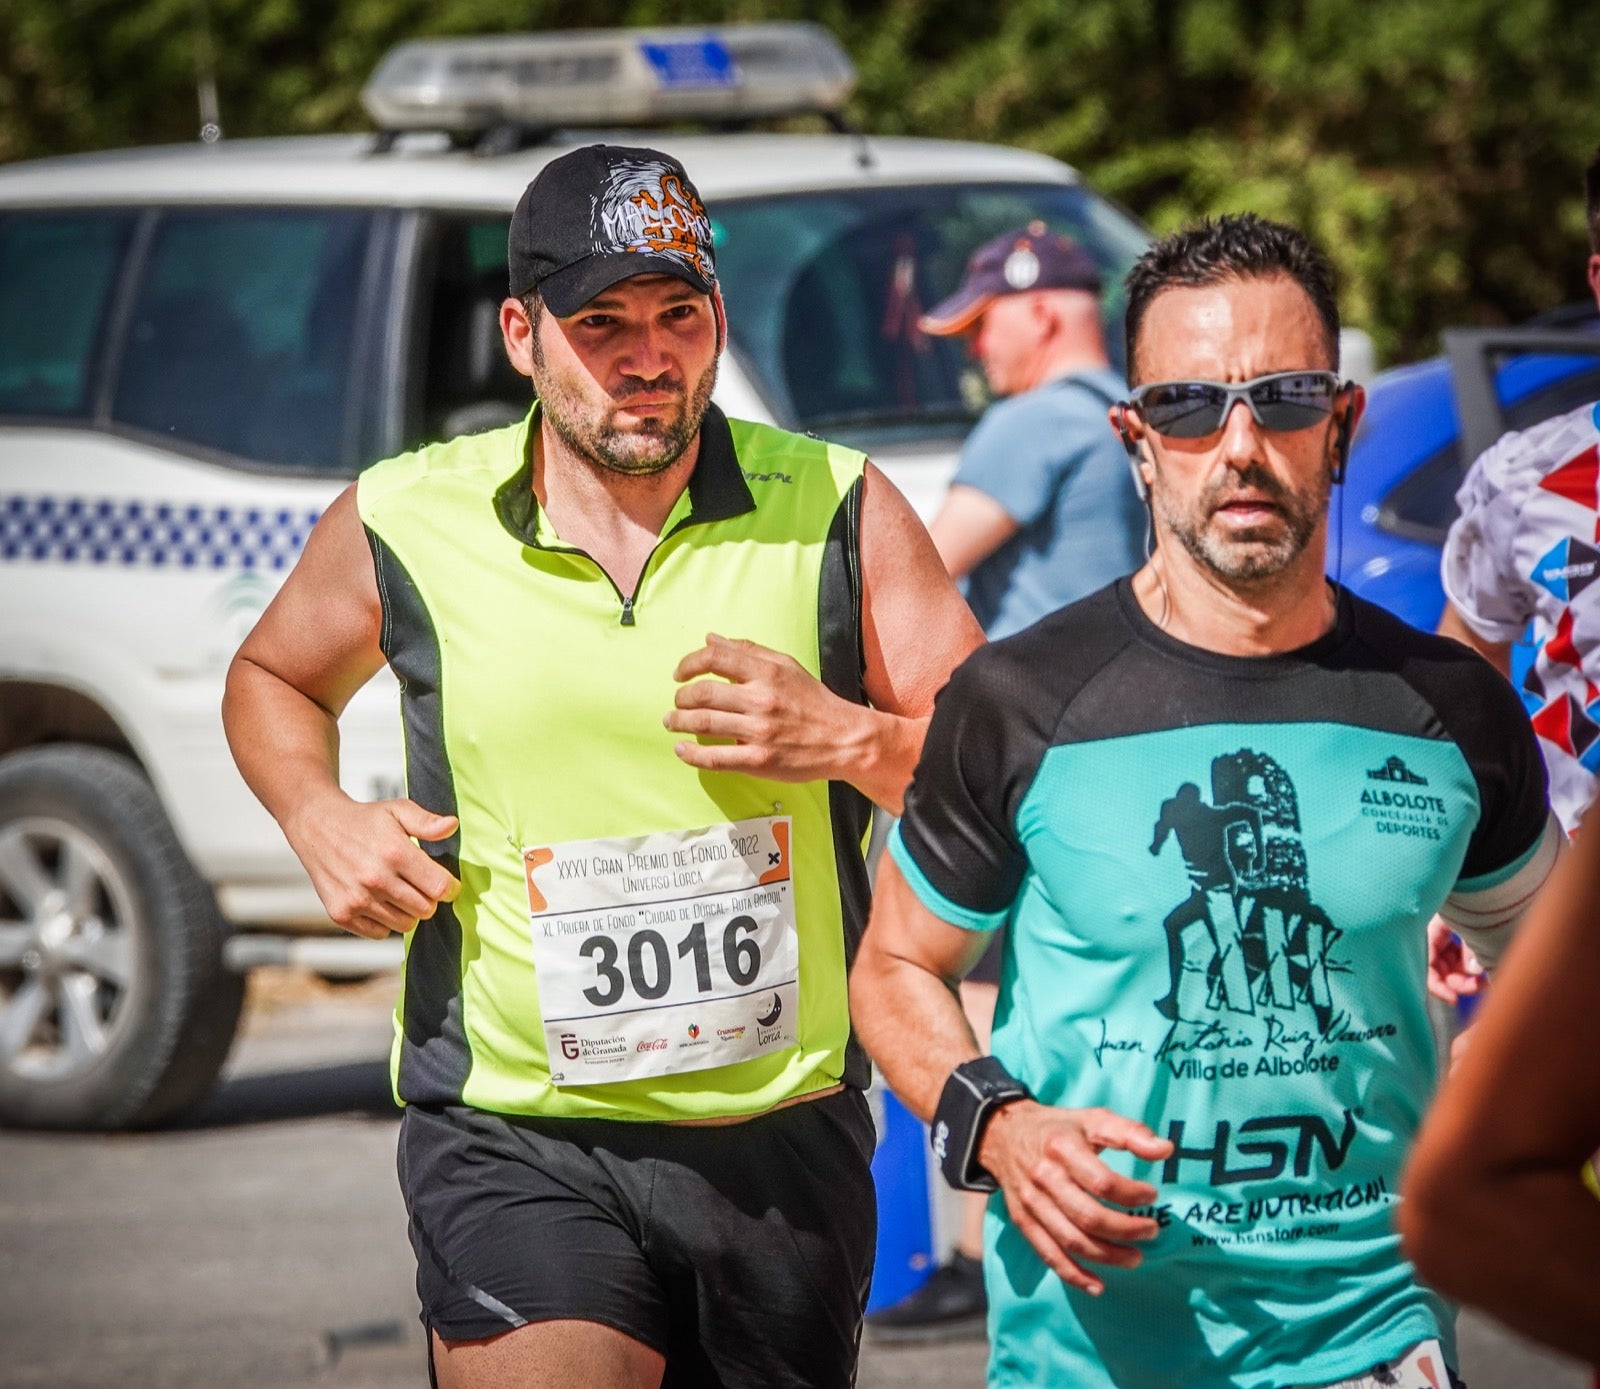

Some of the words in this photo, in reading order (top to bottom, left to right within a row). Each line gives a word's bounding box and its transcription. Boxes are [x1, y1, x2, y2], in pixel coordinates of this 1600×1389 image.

[1360, 789, 1446, 814] ALBOLOTE
[1376, 821, 1440, 840] DEPORTES
[557, 860, 587, 880] XXXV
[731, 835, 759, 858] 2022
[542, 922, 554, 937] XL
[579, 915, 761, 1007] 3016
[580, 1035, 626, 1048] Diputación
[582, 1048, 592, 1056] de
[592, 1045, 627, 1056] Granada
[1263, 1014, 1318, 1060] Ruiz
[1168, 1058, 1217, 1081] Villa
[1221, 1058, 1249, 1079] de
[1254, 1054, 1340, 1077] Albolote
[1162, 1109, 1357, 1186] HSN
[1184, 1201, 1243, 1225] ARE
[1248, 1176, 1390, 1221] NUTRITION!
